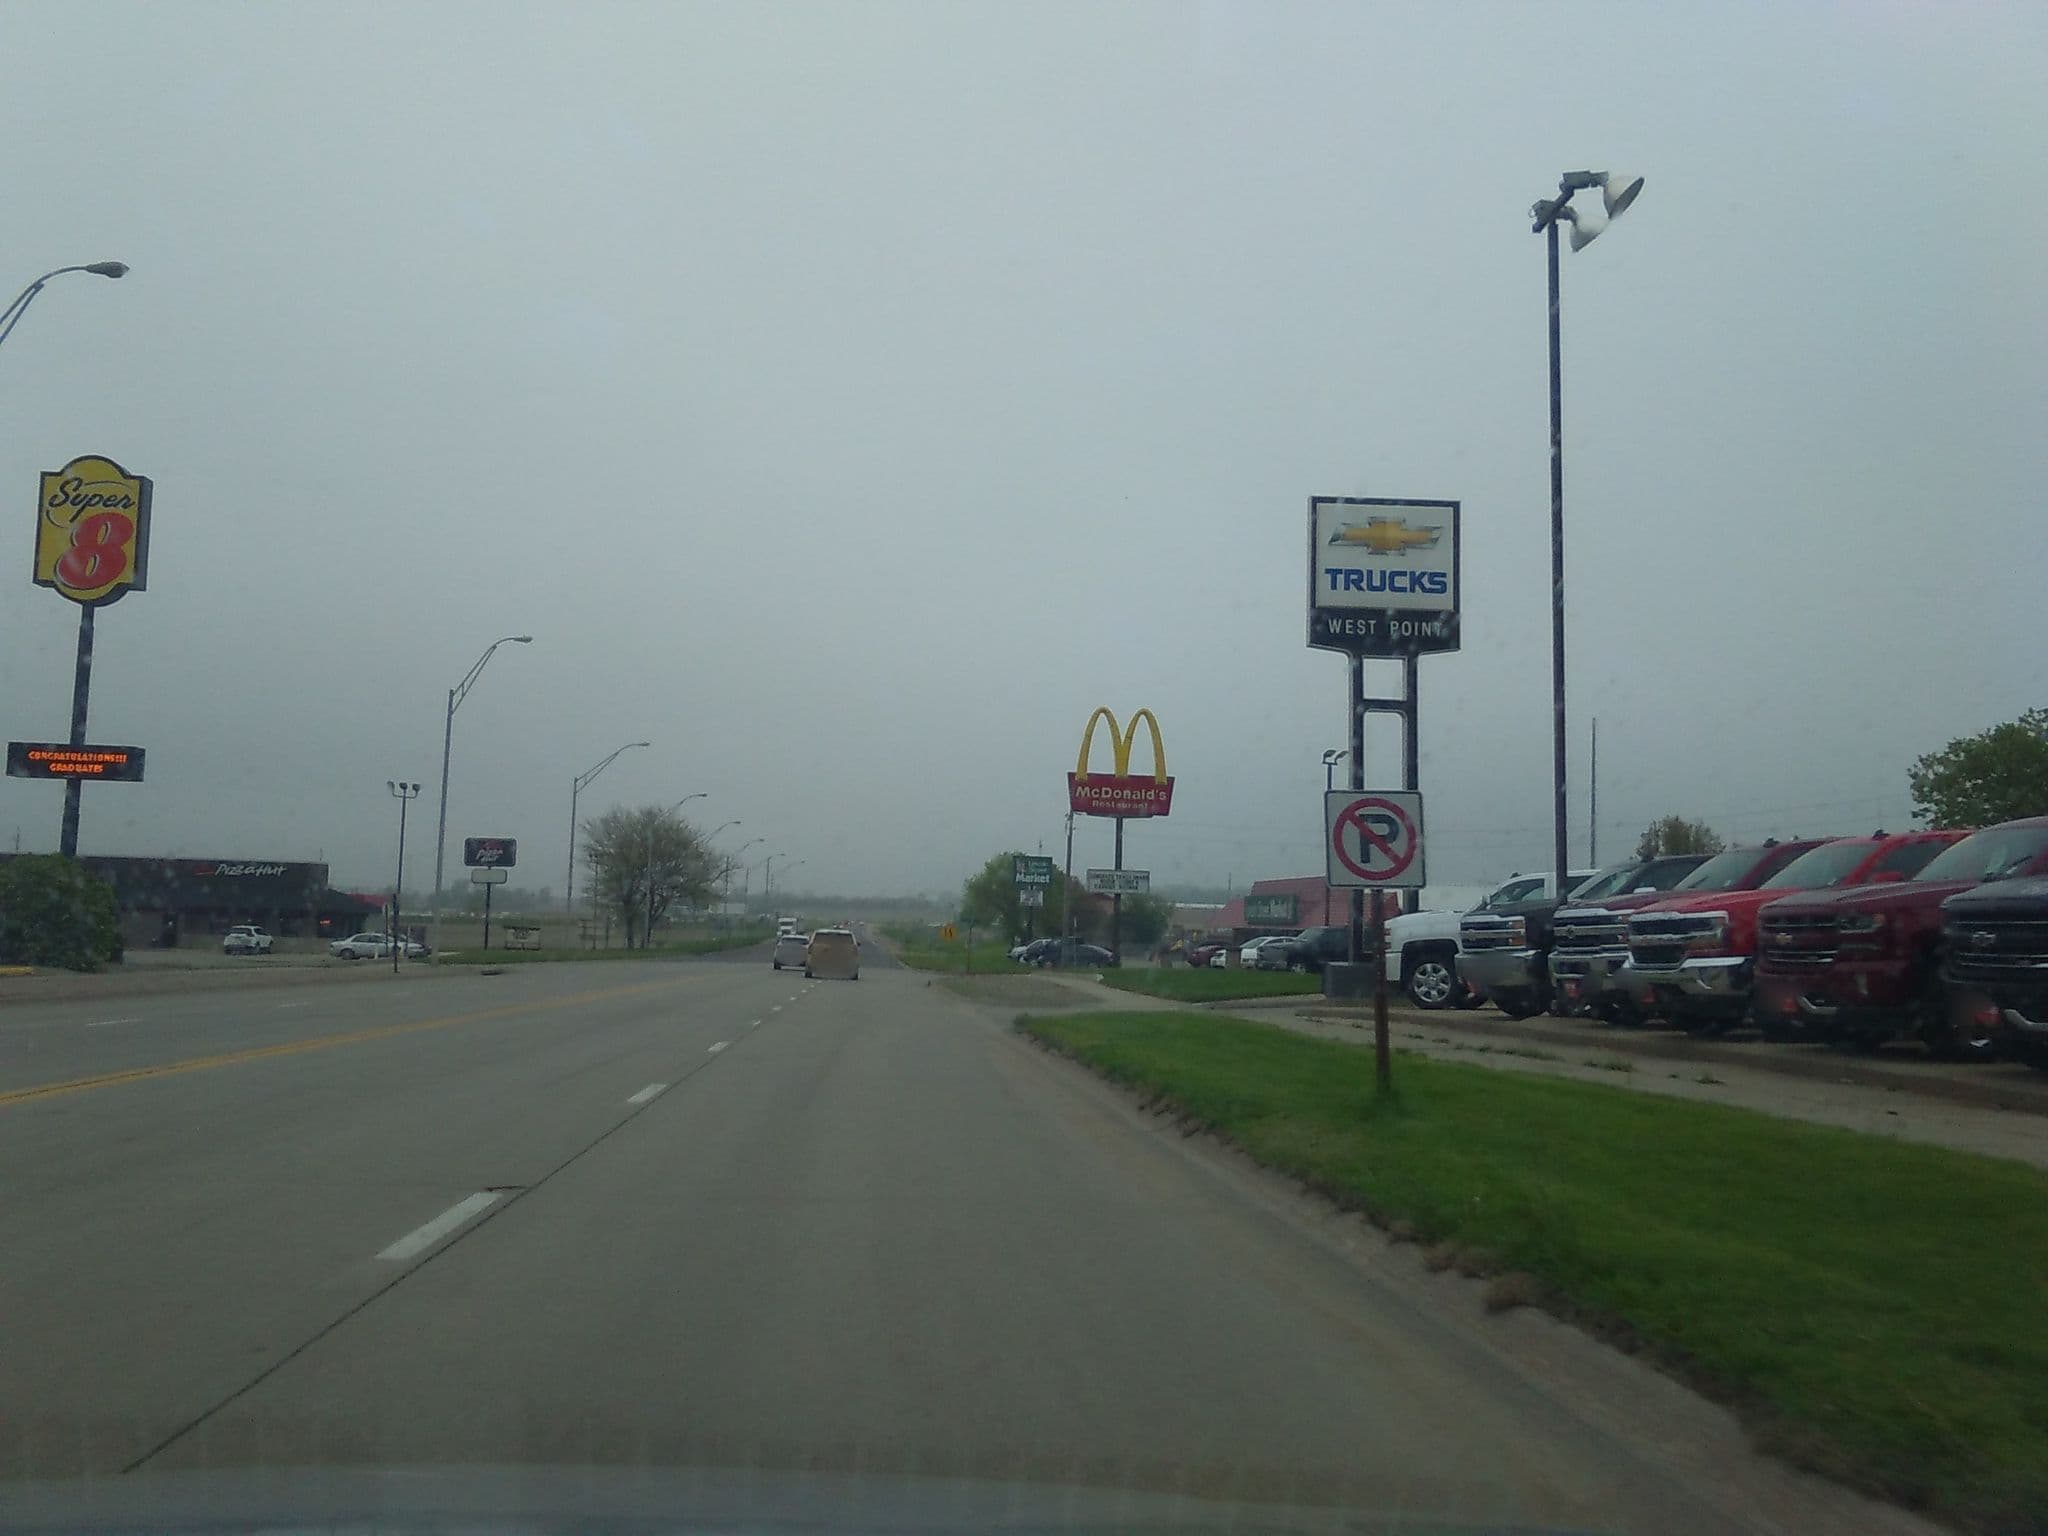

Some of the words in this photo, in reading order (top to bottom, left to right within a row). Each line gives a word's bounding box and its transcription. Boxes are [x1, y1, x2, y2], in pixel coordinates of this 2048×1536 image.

[48, 478, 136, 523] Super
[54, 512, 134, 590] 8
[1324, 568, 1447, 594] TRUCKS
[1328, 618, 1377, 634] WEST
[1390, 620, 1442, 637] POINT
[50, 763, 103, 773] GRADUATES
[1075, 786, 1167, 801] McDonald's
[1092, 799, 1148, 809] Restaurant
[1016, 872, 1050, 883] Market
